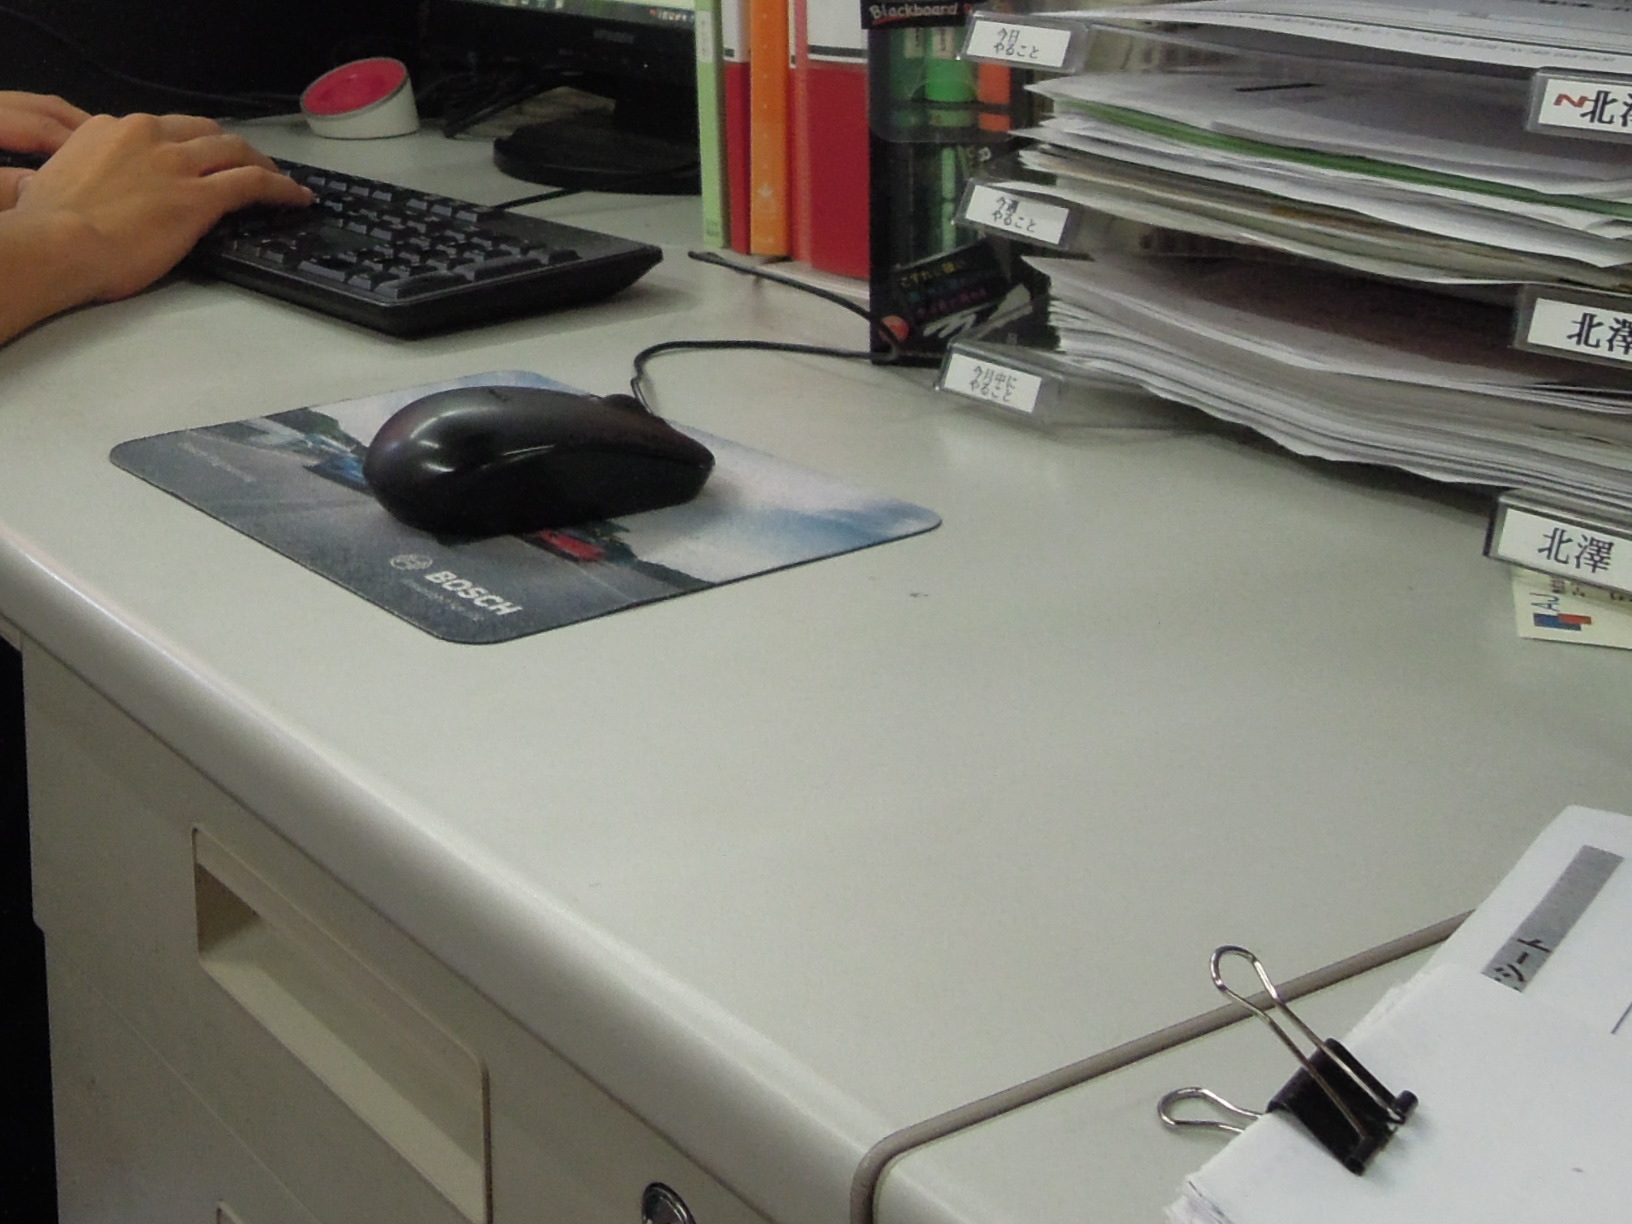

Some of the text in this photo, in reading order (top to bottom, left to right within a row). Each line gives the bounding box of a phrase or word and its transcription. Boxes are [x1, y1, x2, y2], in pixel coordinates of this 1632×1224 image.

[870, 2, 959, 19] Blackboard
[996, 28, 1020, 42] 今日
[993, 42, 1040, 60] やること
[992, 210, 1036, 233] やること
[1537, 527, 1615, 573] 北澤
[424, 570, 524, 616] BOSCH
[1493, 937, 1553, 992] シート
